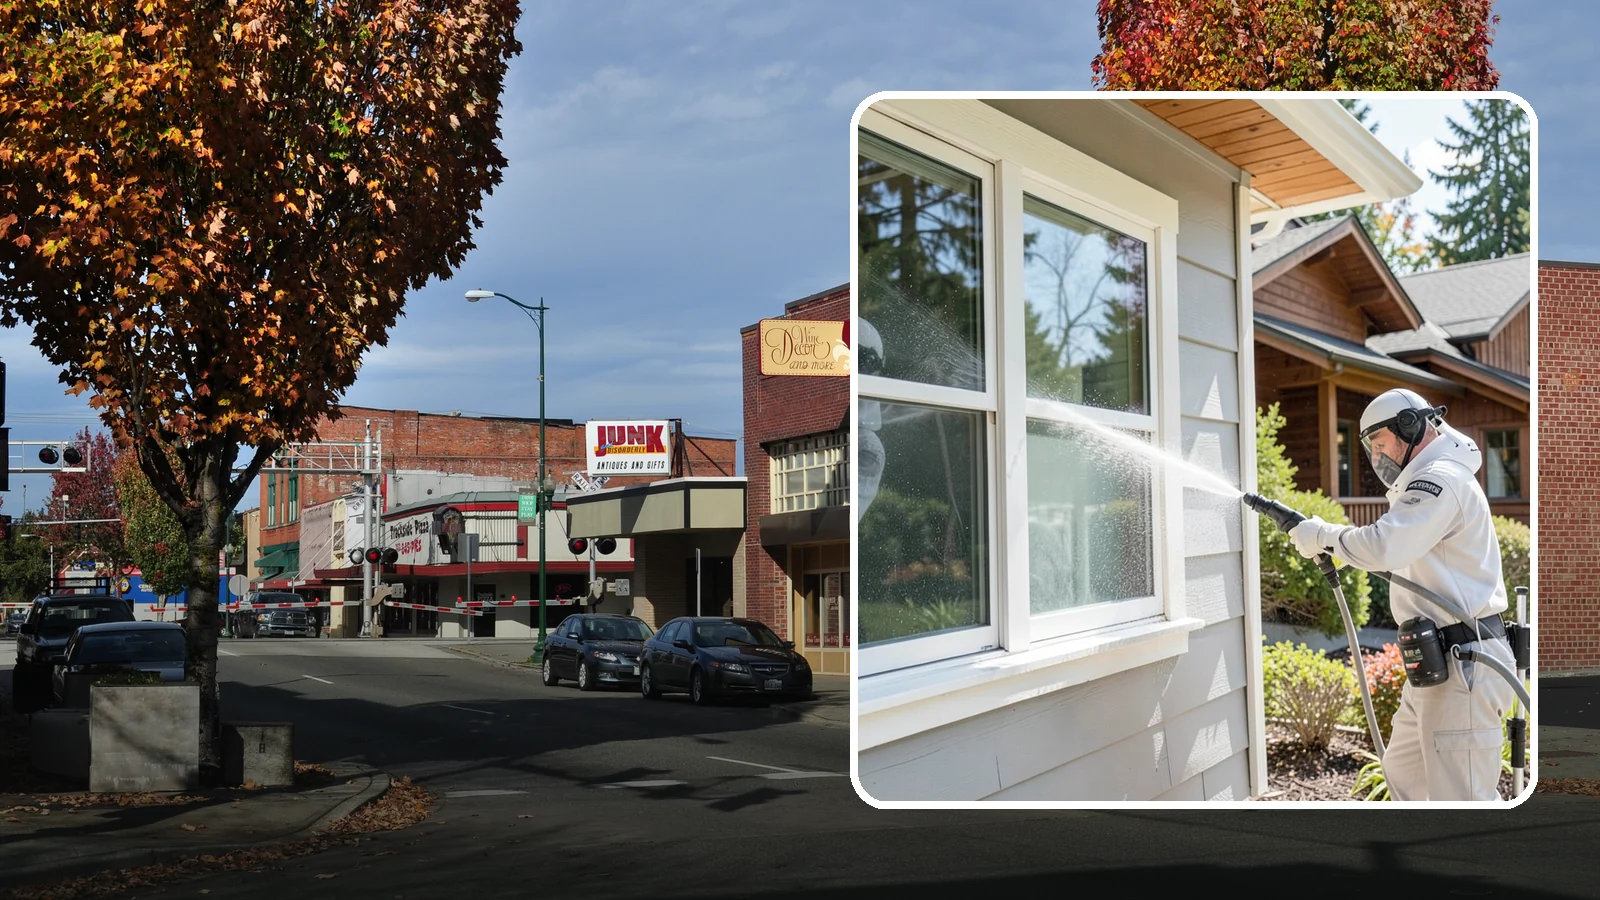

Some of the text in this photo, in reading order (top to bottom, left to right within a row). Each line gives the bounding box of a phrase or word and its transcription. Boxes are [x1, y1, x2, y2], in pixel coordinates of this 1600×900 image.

[595, 425, 665, 457] JUNK
[607, 446, 646, 454] DISORDERLY
[597, 461, 665, 470] ANTIQUES AND GIFTS
[414, 519, 429, 535] Pizza
